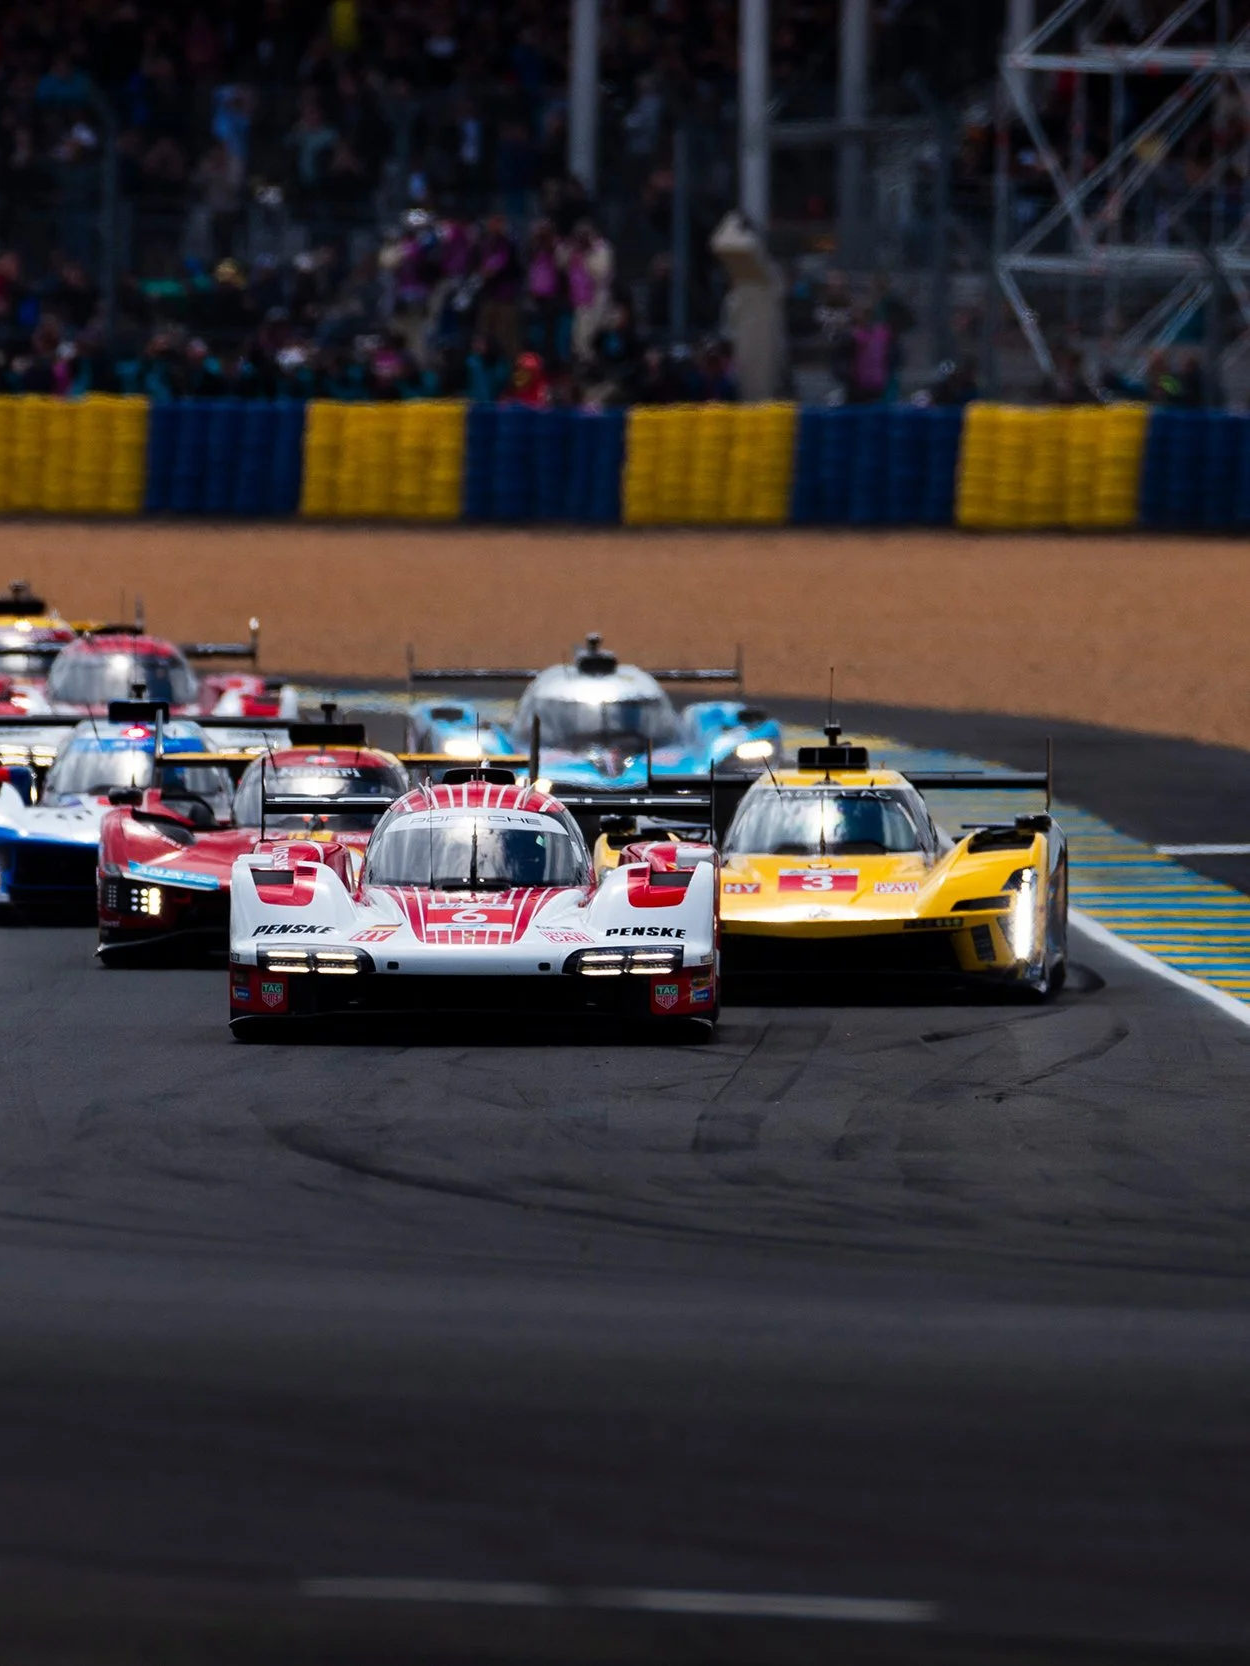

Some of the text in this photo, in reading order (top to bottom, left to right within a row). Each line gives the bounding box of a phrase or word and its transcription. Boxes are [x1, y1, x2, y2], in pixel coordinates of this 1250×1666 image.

[724, 884, 760, 893] HY
[801, 875, 833, 892] 3
[451, 908, 488, 923] 6
[251, 924, 336, 937] PENSKE
[355, 931, 391, 941] HY
[605, 927, 687, 939] PENSKE
[263, 984, 281, 994] TAG
[657, 985, 677, 995] TAG
